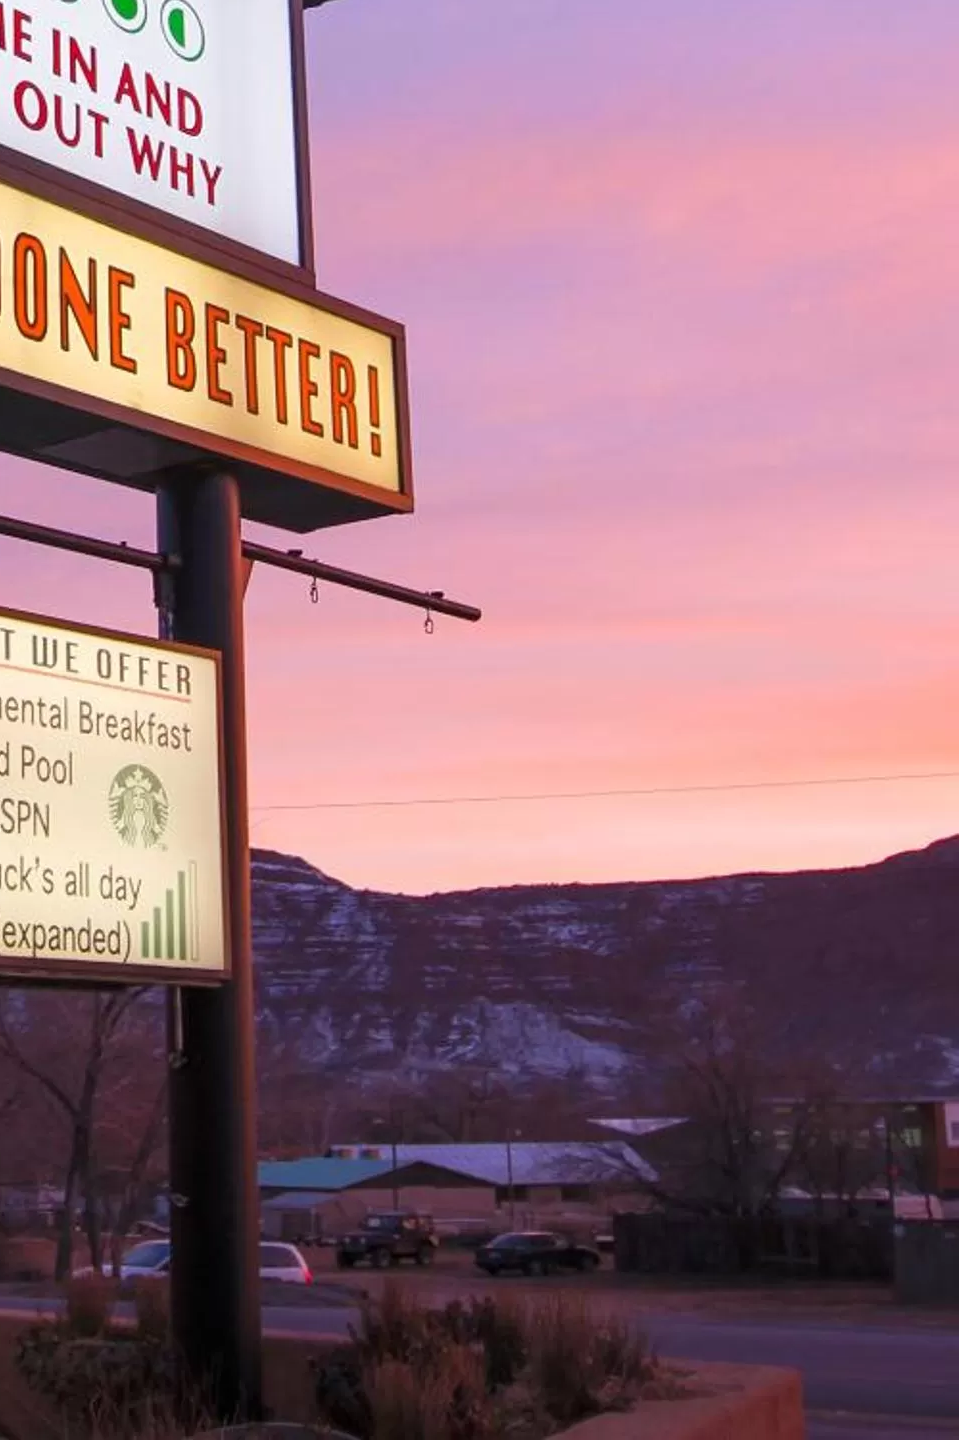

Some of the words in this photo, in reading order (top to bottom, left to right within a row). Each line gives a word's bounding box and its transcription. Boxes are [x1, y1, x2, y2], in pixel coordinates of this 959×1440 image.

[51, 28, 98, 93] IN
[114, 62, 203, 137] AND
[13, 80, 109, 158] OUT
[127, 128, 223, 207] WHY
[164, 287, 382, 457] BETTER!
[32, 634, 80, 674] WE
[96, 647, 192, 696] OFFER
[78, 700, 192, 752] Breakfast
[20, 745, 74, 785] Pool
[64, 864, 90, 898] all
[99, 867, 142, 911] day
